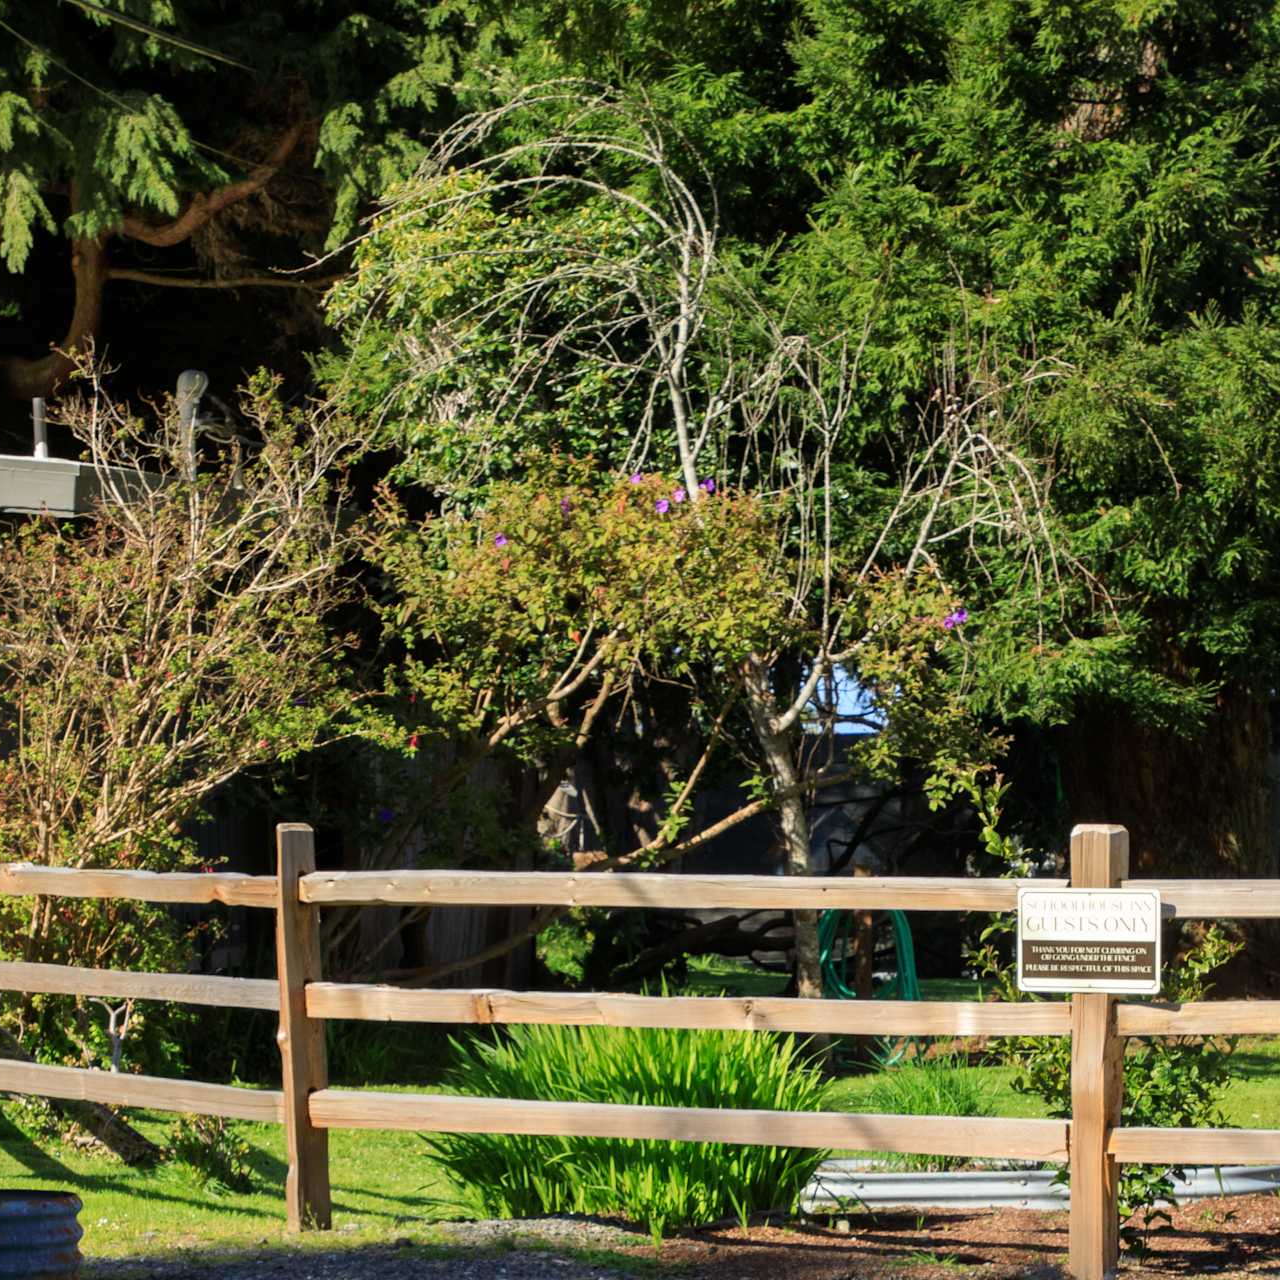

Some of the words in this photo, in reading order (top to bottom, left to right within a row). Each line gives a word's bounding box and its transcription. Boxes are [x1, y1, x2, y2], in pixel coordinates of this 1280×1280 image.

[1130, 900, 1151, 911] INN
[1026, 917, 1099, 932] GUESTS
[1103, 917, 1151, 932] ONLY
[1076, 954, 1100, 962] UNDER
[1100, 954, 1112, 962] THE
[1025, 963, 1050, 972] PLEASE
[1060, 964, 1102, 973] RESPECTFUL
[1113, 965, 1129, 973] THIS
